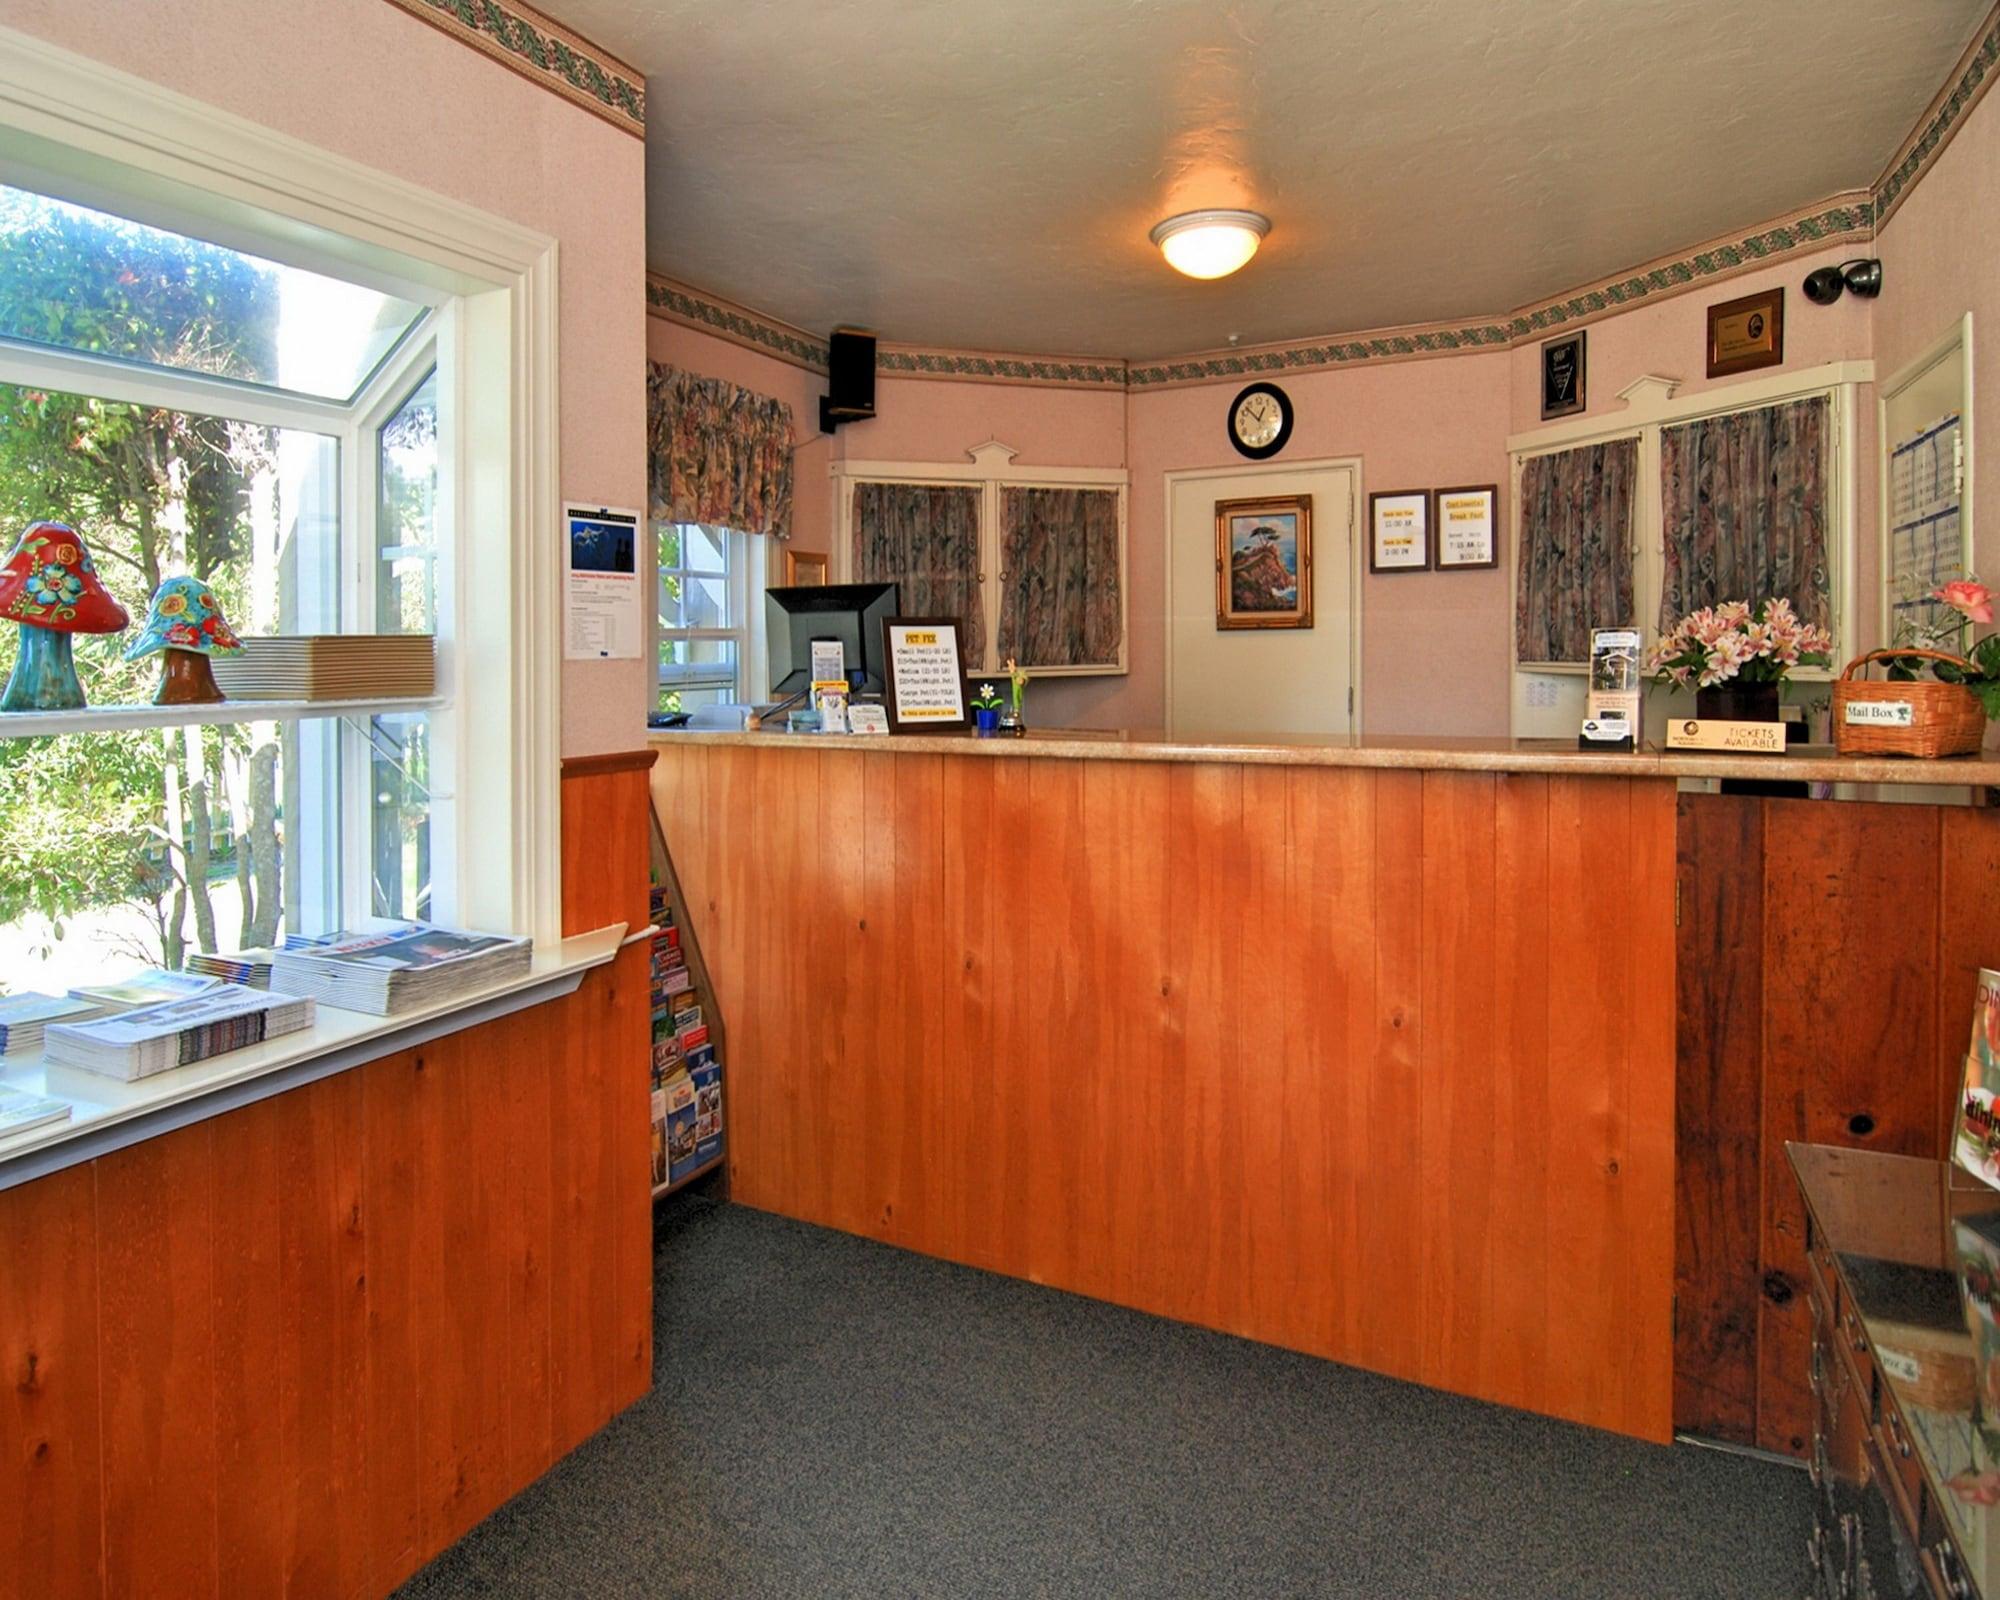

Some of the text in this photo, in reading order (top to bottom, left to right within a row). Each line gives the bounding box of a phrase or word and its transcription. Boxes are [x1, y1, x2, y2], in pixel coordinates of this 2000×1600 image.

[905, 633, 919, 644] PET
[1848, 706, 1893, 718] Mail Box
[1729, 727, 1774, 739] TICKETS
[1724, 737, 1778, 749] AVAILABLE
